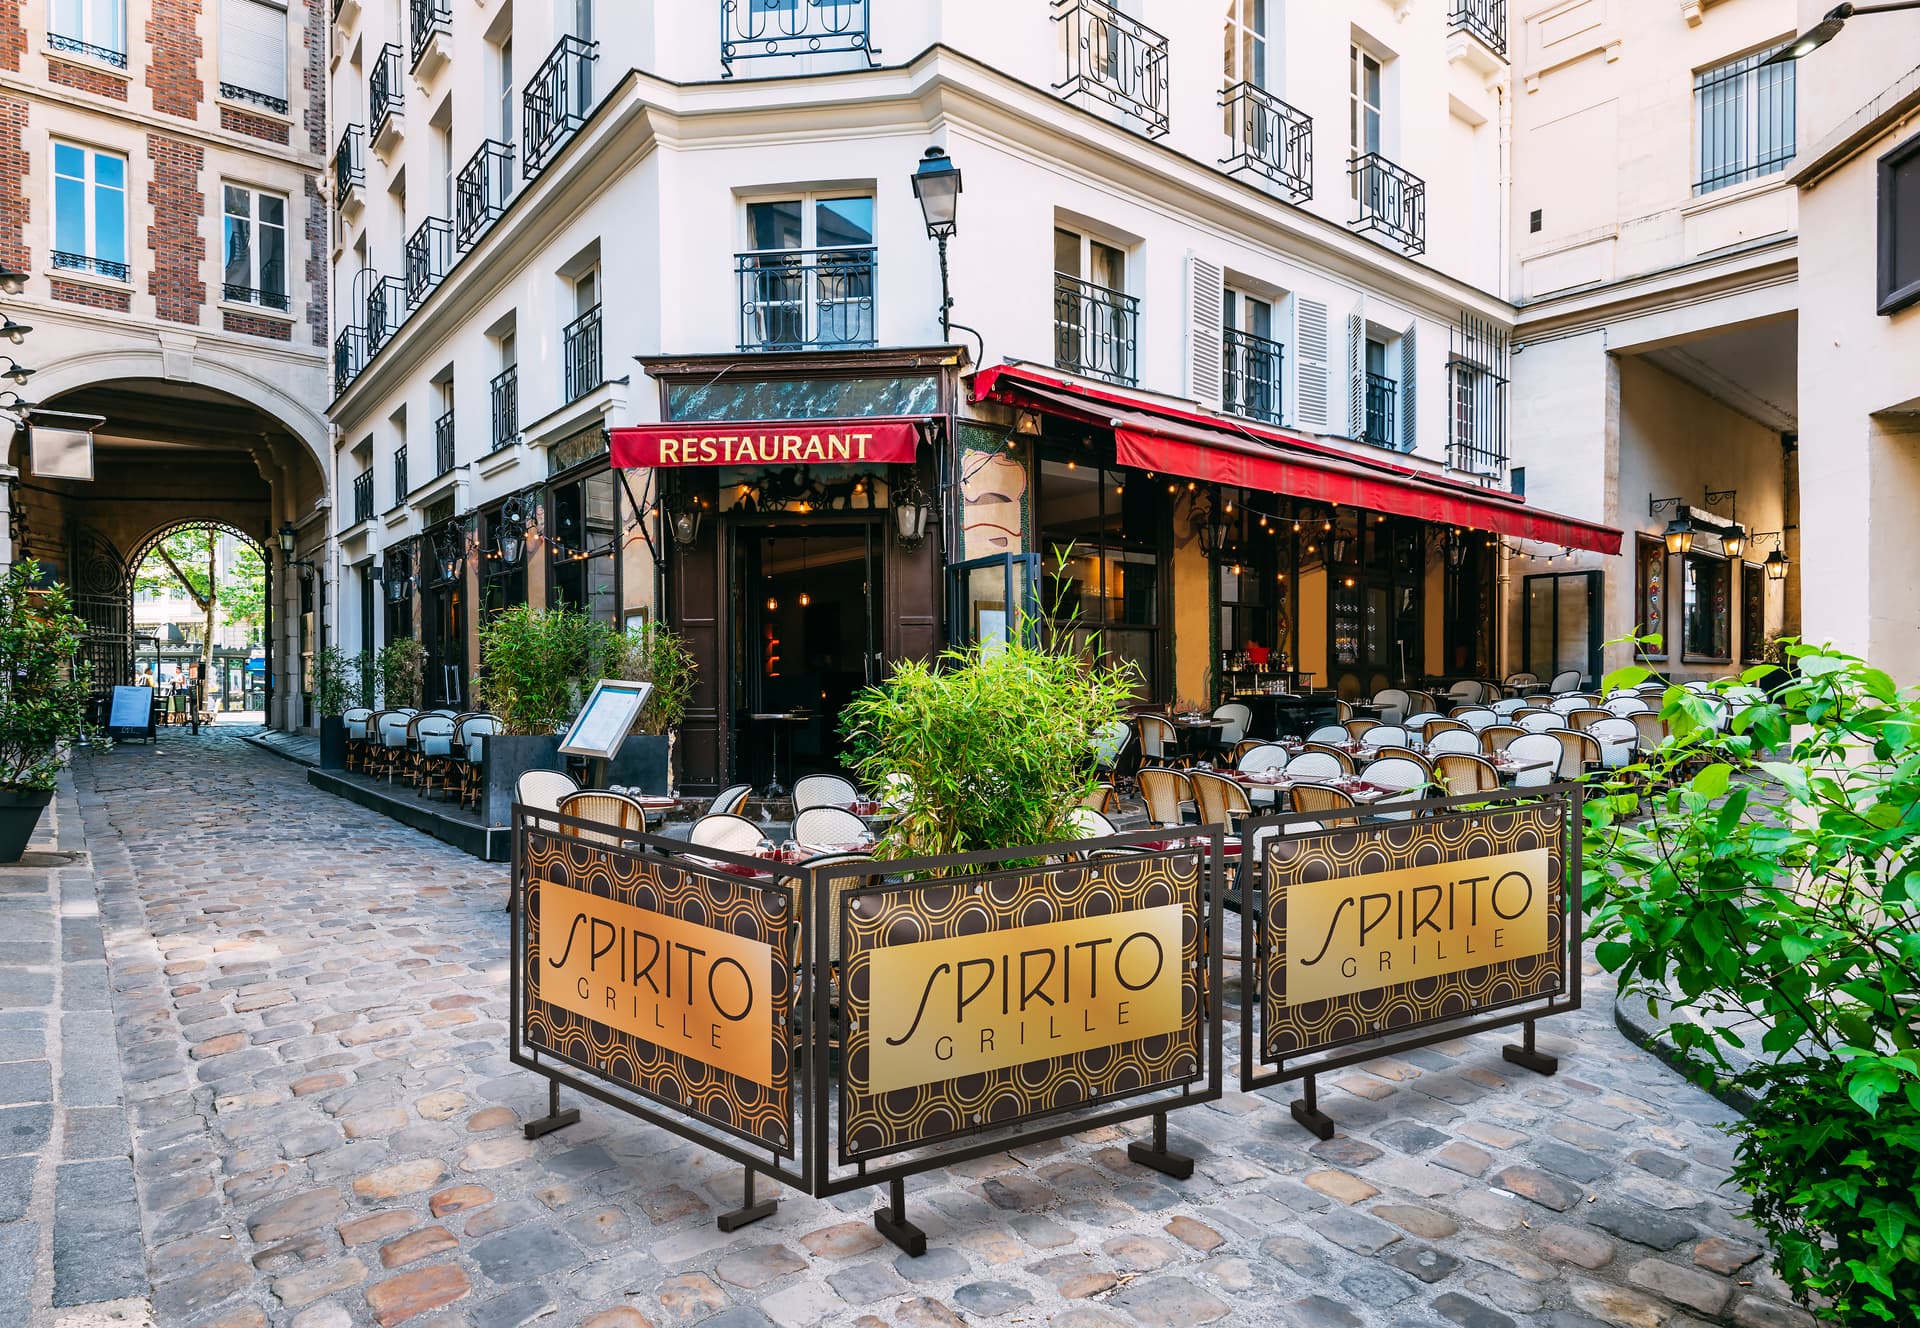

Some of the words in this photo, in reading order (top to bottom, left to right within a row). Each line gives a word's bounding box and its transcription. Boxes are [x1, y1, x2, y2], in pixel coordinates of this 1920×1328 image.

[659, 433, 873, 463] RESTAURANT
[1300, 871, 1533, 966] SPIRITO
[1341, 928, 1505, 978] GRILLE
[548, 912, 754, 1022] SPIRITO
[886, 931, 1164, 1047] SPIRITO
[577, 976, 722, 1050] GRILLE
[935, 1000, 1130, 1061] GRILLE
